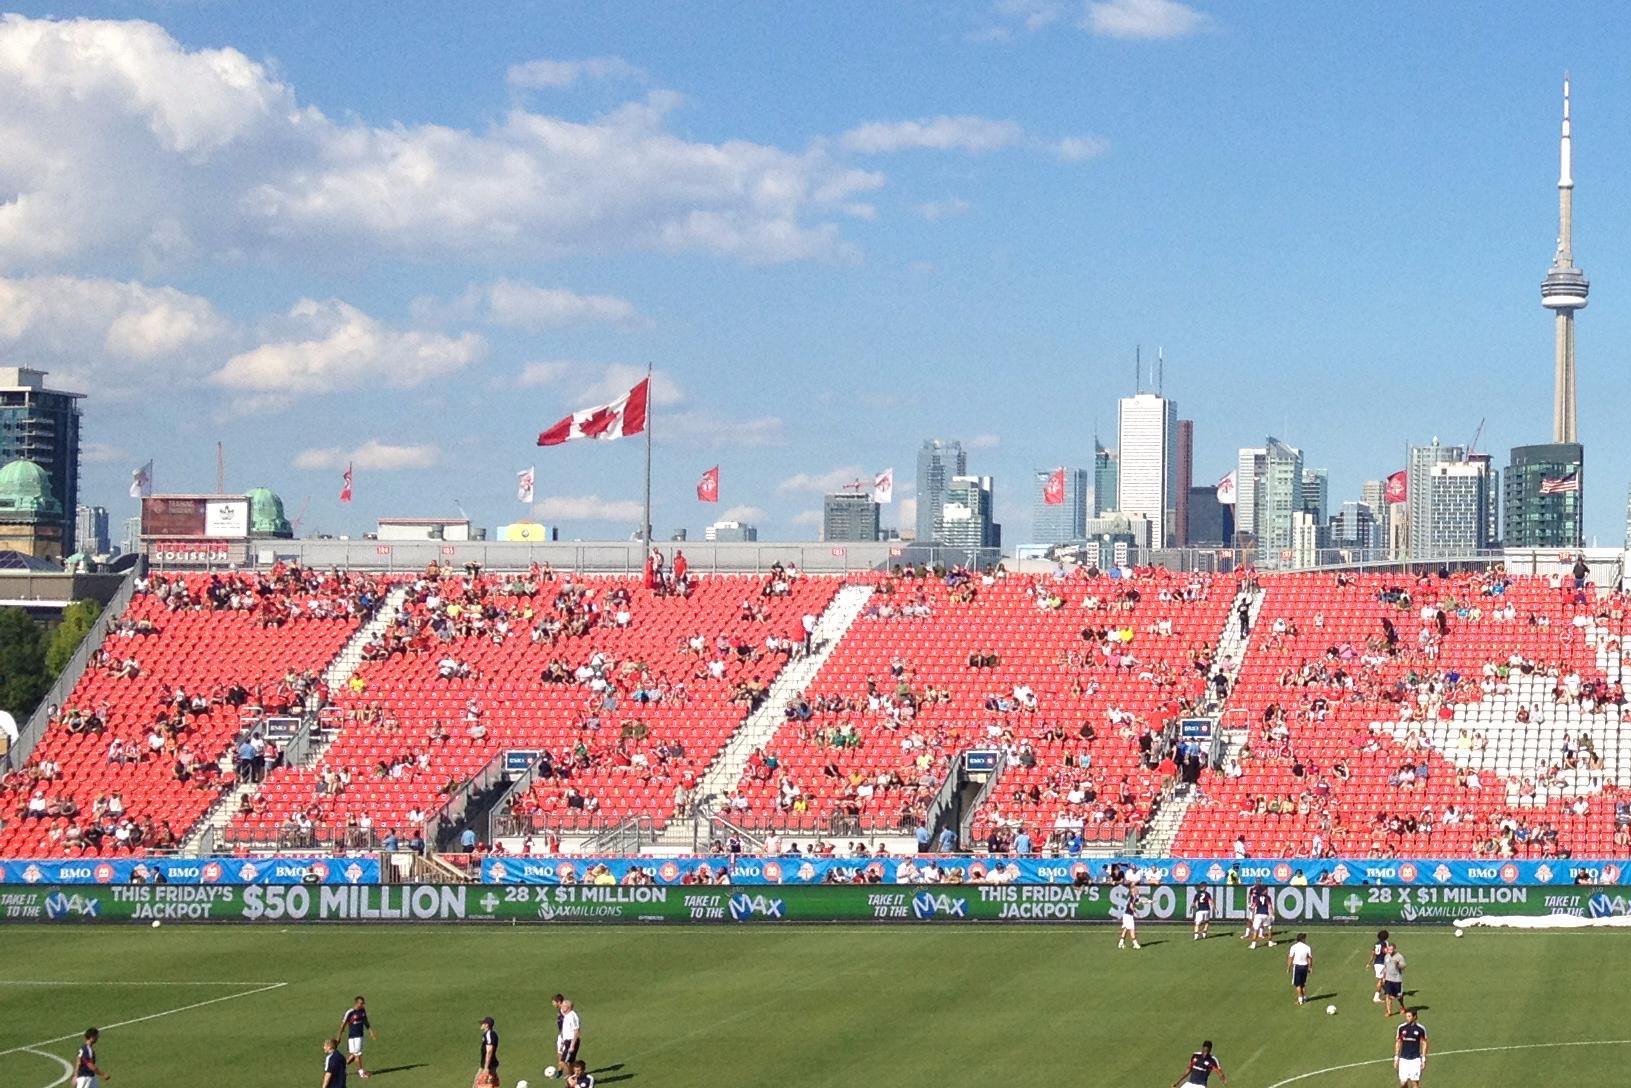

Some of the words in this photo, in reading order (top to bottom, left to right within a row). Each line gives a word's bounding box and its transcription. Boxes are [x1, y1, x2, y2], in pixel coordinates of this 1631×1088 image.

[156, 552, 227, 560] COLISEUM
[60, 868, 90, 878] BMO
[168, 868, 198, 878] BMO
[276, 868, 305, 877] BMO
[524, 866, 554, 876] BMO
[1038, 867, 1066, 876] BMO
[1242, 868, 1271, 877] BMO
[1367, 868, 1396, 878] BMO
[1468, 868, 1497, 878] BMO
[2, 894, 25, 905] TAKE
[26, 894, 36, 905] IT
[112, 887, 153, 902] THIS
[156, 887, 232, 902] FRIDAY'S
[505, 888, 528, 902] 28
[535, 888, 549, 902] X
[555, 886, 576, 902] $1
[581, 888, 666, 902] MILLION
[979, 887, 1019, 901] THIS
[1022, 887, 1099, 901] FRIDAY'S
[1200, 894, 1206, 902] 2
[1368, 888, 1391, 902] 28
[1398, 888, 1412, 902] X
[1418, 887, 1437, 903] $1
[1444, 888, 1526, 902] MILLION
[243, 885, 309, 919] $50
[320, 886, 466, 919] MILLION
[683, 895, 706, 906] TAKE
[707, 895, 719, 906] IT
[868, 894, 892, 906] TAKE
[893, 894, 904, 906] IT
[1545, 896, 1568, 907] TAKE
[1568, 896, 1580, 907] IT
[7, 907, 21, 918] TO
[23, 907, 40, 918] THE
[131, 903, 212, 918] JACKPOT
[690, 907, 703, 918] TO
[705, 907, 724, 918] THE
[876, 906, 888, 918] TO
[890, 906, 909, 918] THE
[1000, 903, 1078, 918] JACKPOT
